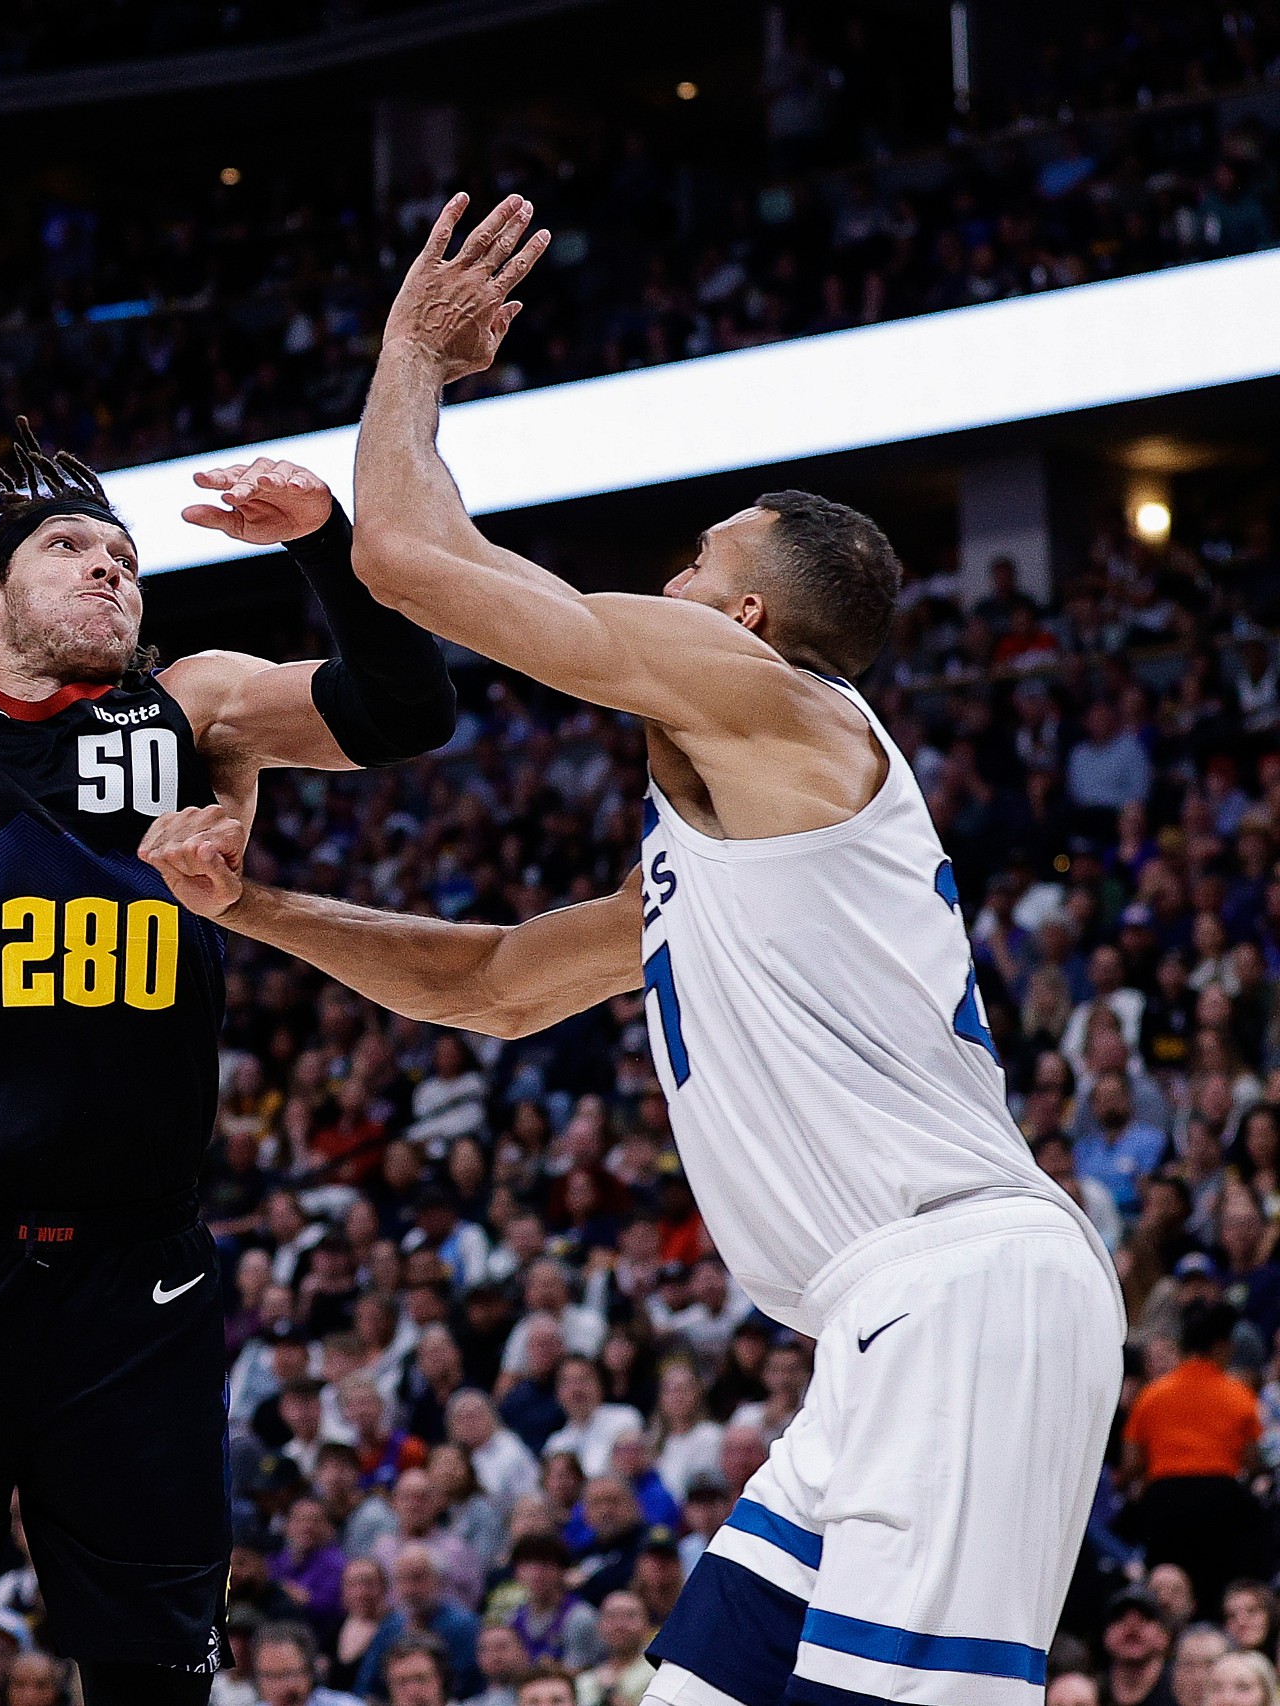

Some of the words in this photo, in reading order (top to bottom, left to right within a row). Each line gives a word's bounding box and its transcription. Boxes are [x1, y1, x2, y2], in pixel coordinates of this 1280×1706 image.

[92, 703, 160, 725] ibotta
[78, 728, 178, 817] 50
[18, 1224, 75, 1242] DNVER
